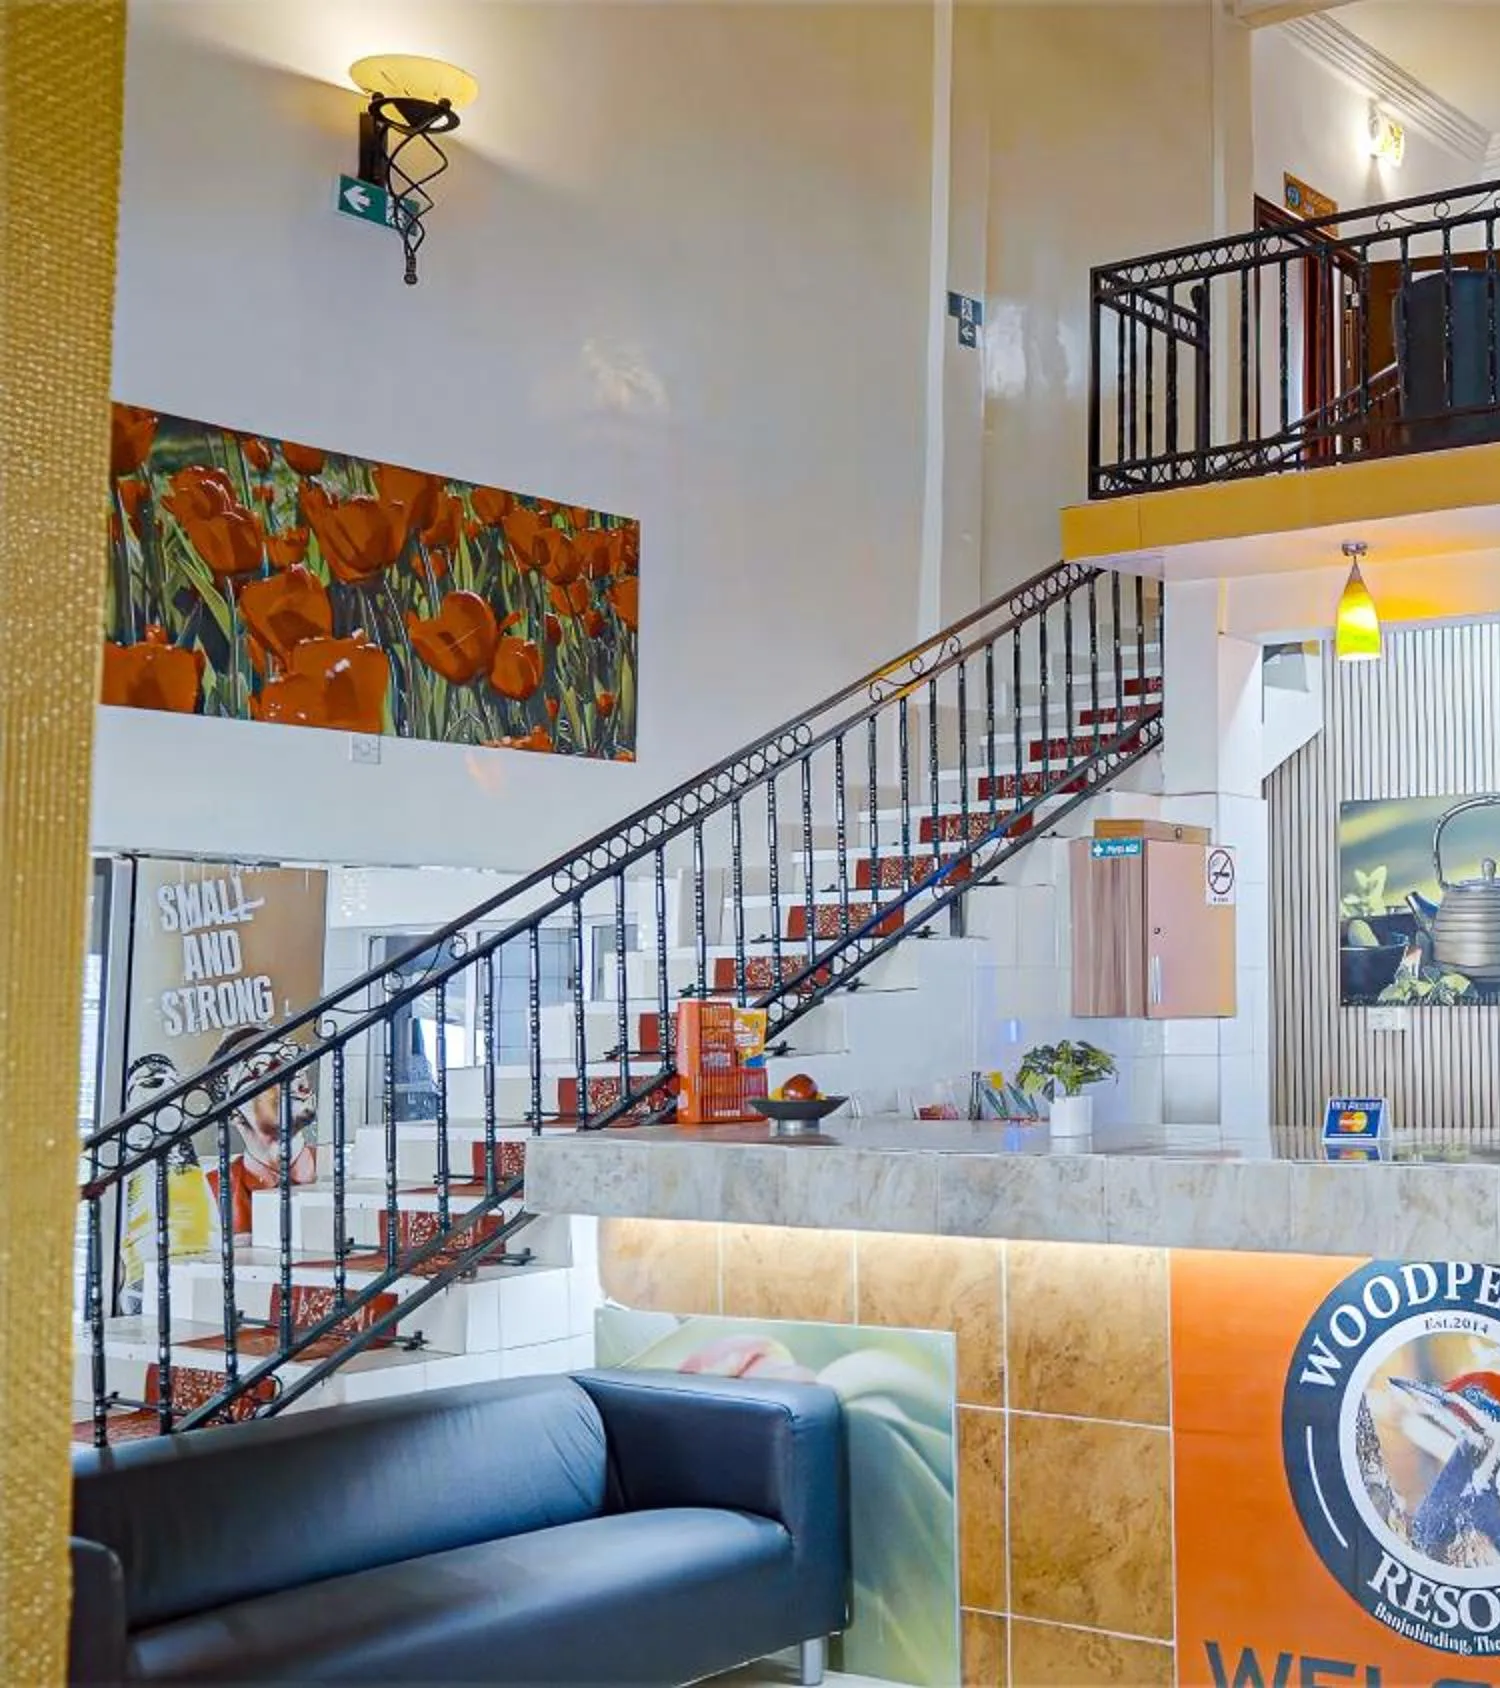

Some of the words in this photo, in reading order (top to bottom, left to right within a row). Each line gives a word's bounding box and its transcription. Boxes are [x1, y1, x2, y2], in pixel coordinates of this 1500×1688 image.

[157, 877, 265, 934] SMALL
[183, 929, 243, 981] AND
[161, 975, 275, 1038] STRONG
[1425, 1316, 1489, 1335] Est.2014
